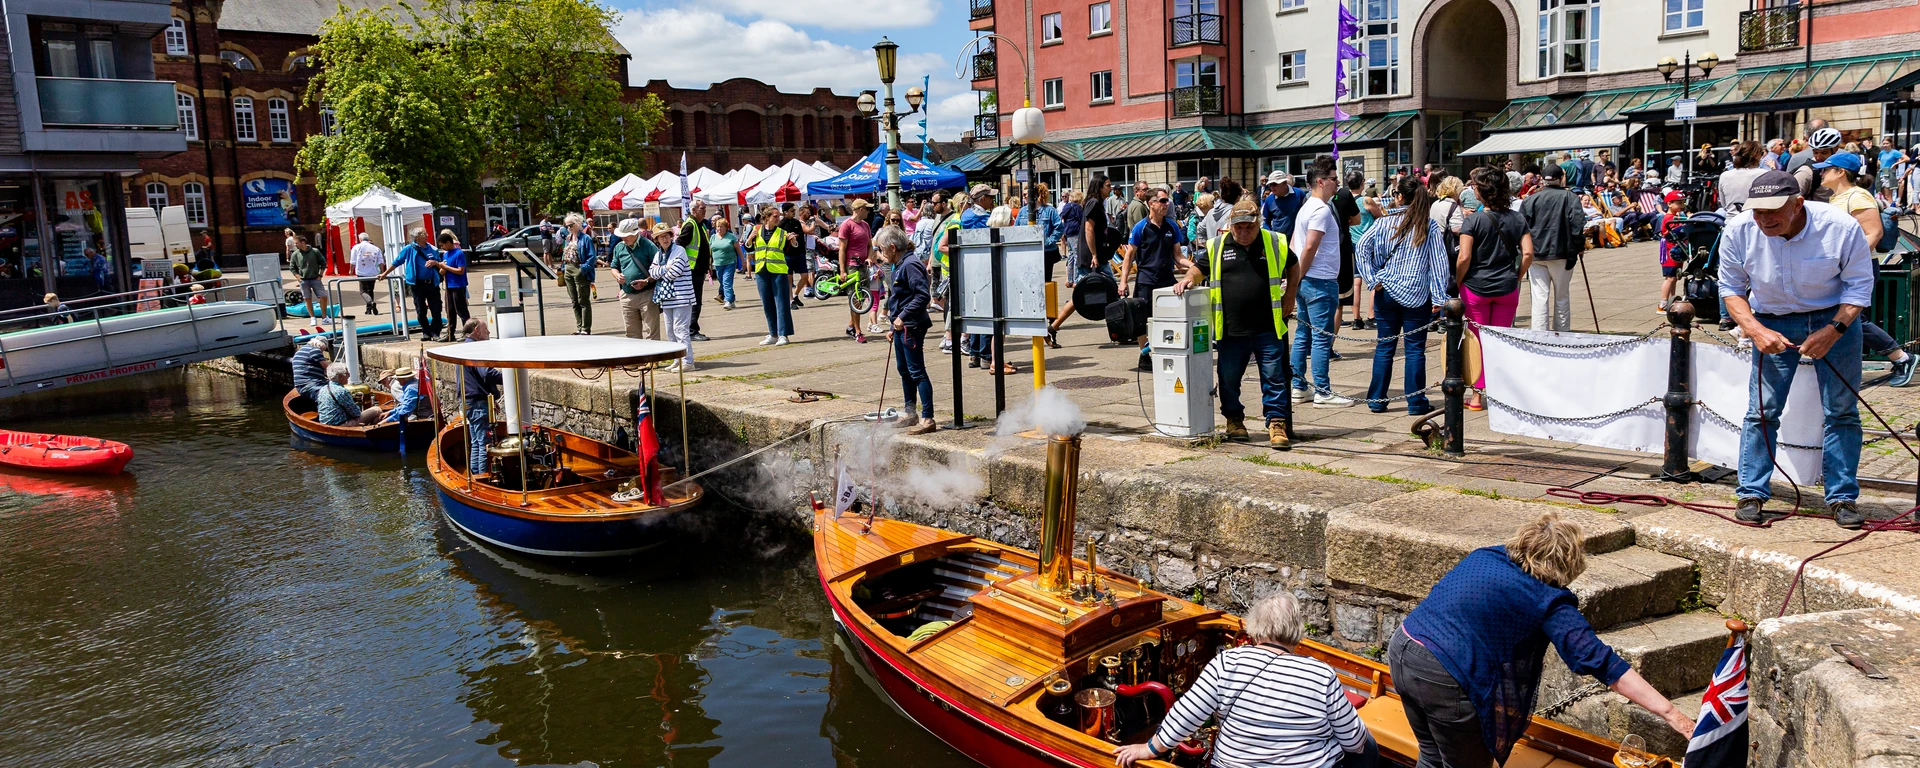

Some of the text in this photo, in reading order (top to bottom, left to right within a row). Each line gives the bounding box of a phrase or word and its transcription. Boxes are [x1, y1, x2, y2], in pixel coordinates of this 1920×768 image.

[65, 190, 92, 210] AS
[66, 362, 157, 384] PRIVATE PROPERTY
[840, 486, 854, 503] SBA
